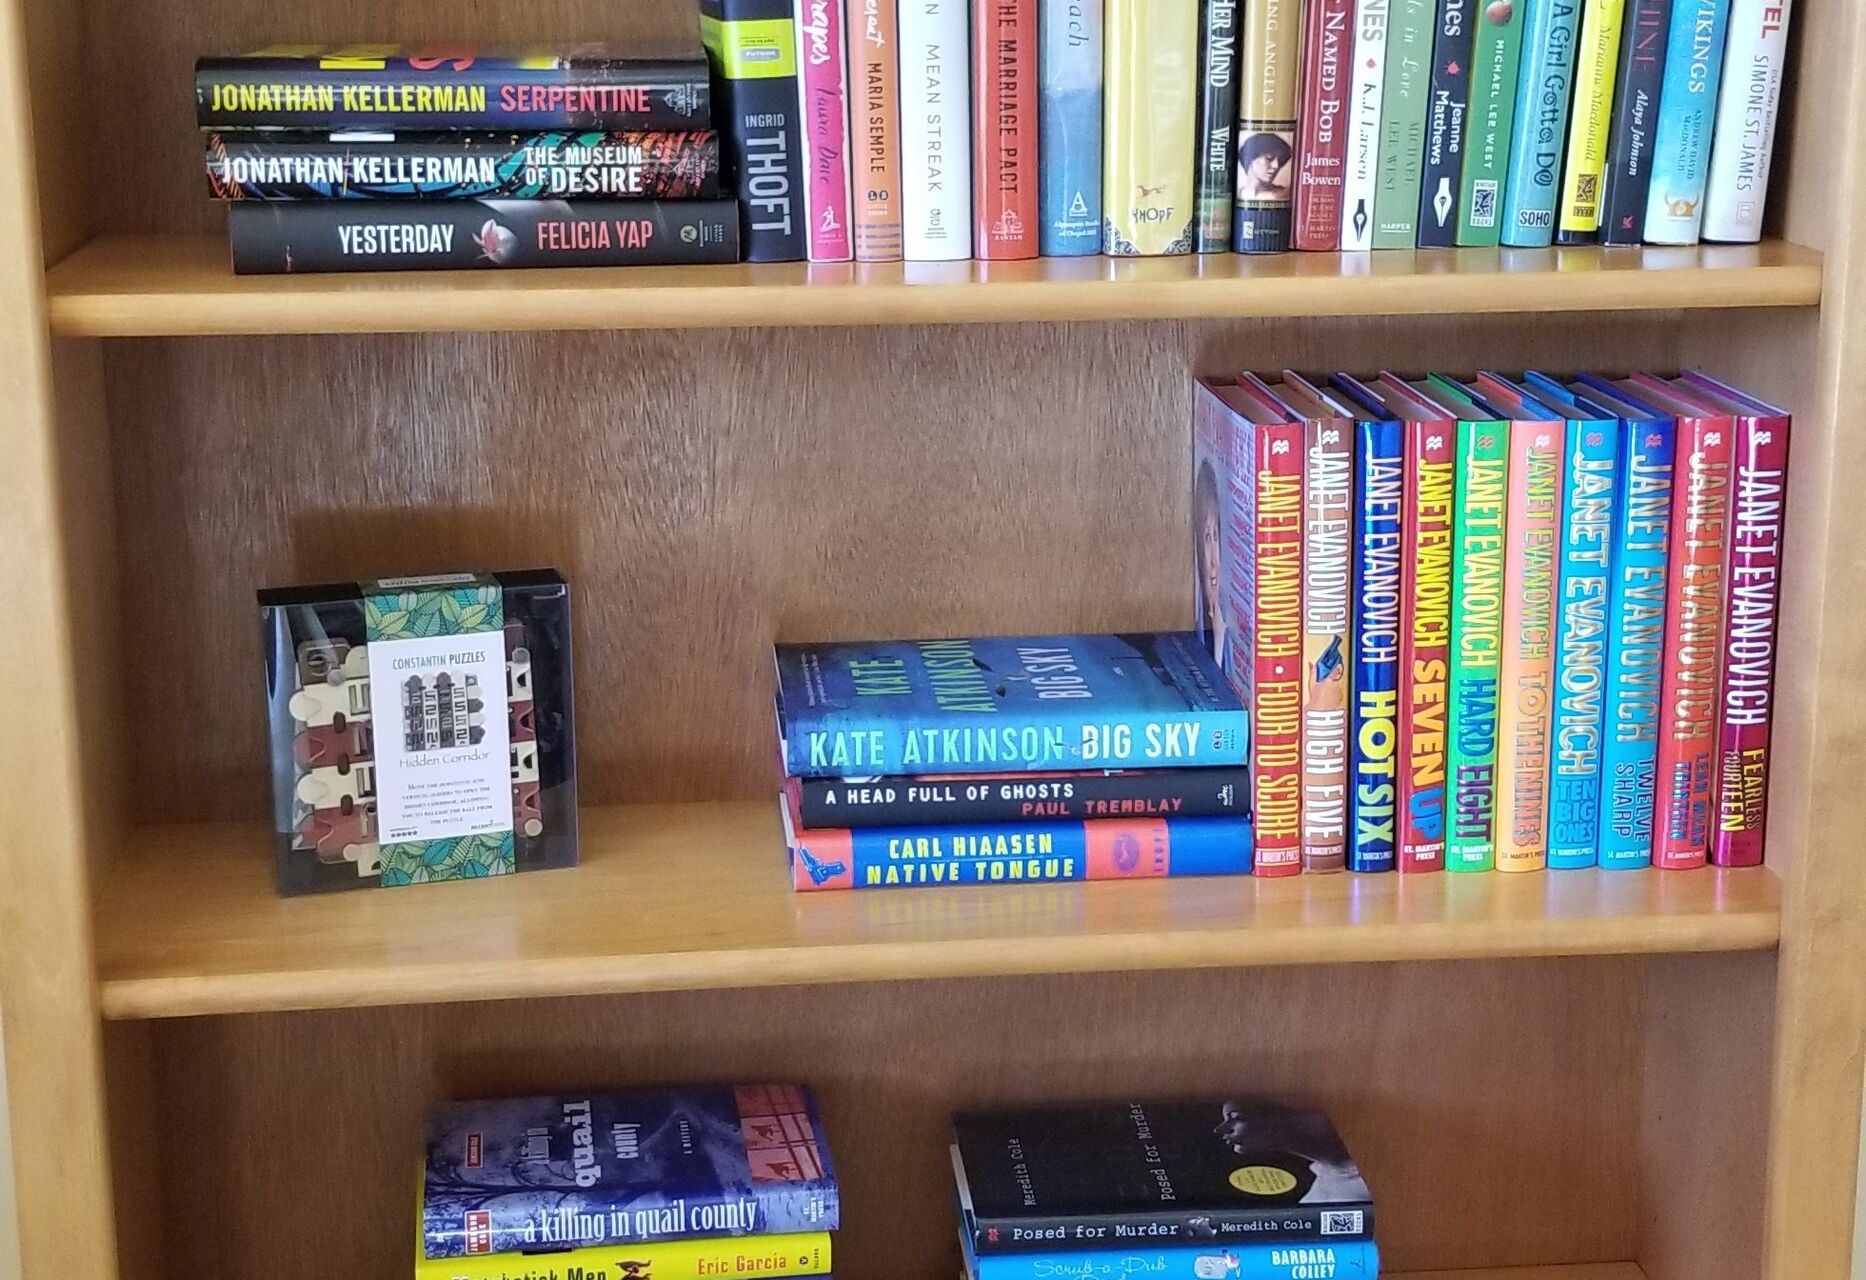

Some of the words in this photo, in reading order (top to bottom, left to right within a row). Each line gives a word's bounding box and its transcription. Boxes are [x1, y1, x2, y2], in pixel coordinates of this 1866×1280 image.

[867, 63, 884, 111] MARIA
[926, 45, 940, 104] MEAN
[998, 39, 1017, 136] MARRIAGE
[1489, 39, 1505, 98] MICHAEL
[1749, 55, 1769, 115] SIMONE
[211, 85, 334, 112] JONATHAN
[343, 85, 486, 112] KELLERMAN
[500, 86, 651, 112] SERPENTINE
[745, 114, 784, 127] INGRID
[1488, 104, 1498, 127] LEE
[1630, 89, 1649, 125] Alaya
[869, 117, 885, 172] SEMPLE
[1210, 127, 1229, 171] WHITE
[1430, 91, 1449, 166] Matthews
[1449, 100, 1465, 153] Jeanne
[1484, 133, 1495, 168] WEST
[1628, 126, 1645, 176] Johnson
[1744, 119, 1760, 139] ST.
[223, 158, 342, 183] JONATHAN
[353, 158, 495, 183] KELLERMAN
[526, 148, 559, 164] THE
[565, 147, 643, 165] MUSEUM
[927, 114, 941, 191] STREAK
[999, 145, 1017, 194] PACT
[1305, 153, 1340, 167] James
[1737, 142, 1755, 191] JAMES
[526, 168, 546, 185] OF
[552, 166, 642, 193] DESIRE
[746, 131, 791, 235] THOFT
[1302, 172, 1340, 185] Bowen
[1519, 211, 1549, 225] SOHO
[1418, 458, 1453, 525] JANET
[1567, 459, 1614, 568] JANET
[1627, 455, 1672, 551] JANET
[1736, 466, 1781, 556] JANET
[1413, 532, 1451, 648] EVANOVICH
[393, 655, 446, 670] CONSTANTIN
[450, 651, 486, 664] PUZZLES
[1616, 566, 1664, 742] EVANOVICH
[1726, 566, 1775, 726] EVANOVICH
[919, 640, 997, 713] ATKINSON
[1557, 576, 1608, 775] EVANOVICH
[810, 731, 884, 766] KATE
[902, 726, 1064, 764] ATKINSON
[1081, 724, 1130, 759] BIG
[1145, 722, 1201, 757] SKY
[1411, 659, 1447, 787] SEVEN
[826, 790, 836, 804] A
[848, 789, 895, 804] HEAD
[908, 787, 956, 802] FULL
[967, 786, 989, 801] OF
[1000, 784, 1074, 799] GHOSTS
[1022, 802, 1070, 816] PAUL
[1085, 799, 1182, 813] TREMBLAY
[1409, 787, 1444, 839] UP
[1557, 780, 1596, 799] TEN
[1612, 762, 1635, 838] SHARP
[1634, 755, 1656, 843] TWELVE
[1720, 751, 1745, 832] FOURTEEN
[1743, 748, 1764, 830] FEARLESS
[889, 839, 942, 859] CARL
[953, 834, 1052, 857] HIAASEN
[867, 863, 959, 885] NATIVE
[976, 859, 1074, 880] TONGUE
[1013, 1226, 1067, 1239] Posed
[1075, 1226, 1105, 1237] for
[1115, 1222, 1179, 1236] Murder
[1221, 1222, 1277, 1232] Meredith
[1283, 1219, 1312, 1230] Cole
[698, 1258, 728, 1274] Eric
[736, 1254, 786, 1271] Garcia
[1272, 1248, 1336, 1265] BARBARA
[1292, 1266, 1336, 1279] COLLEY
